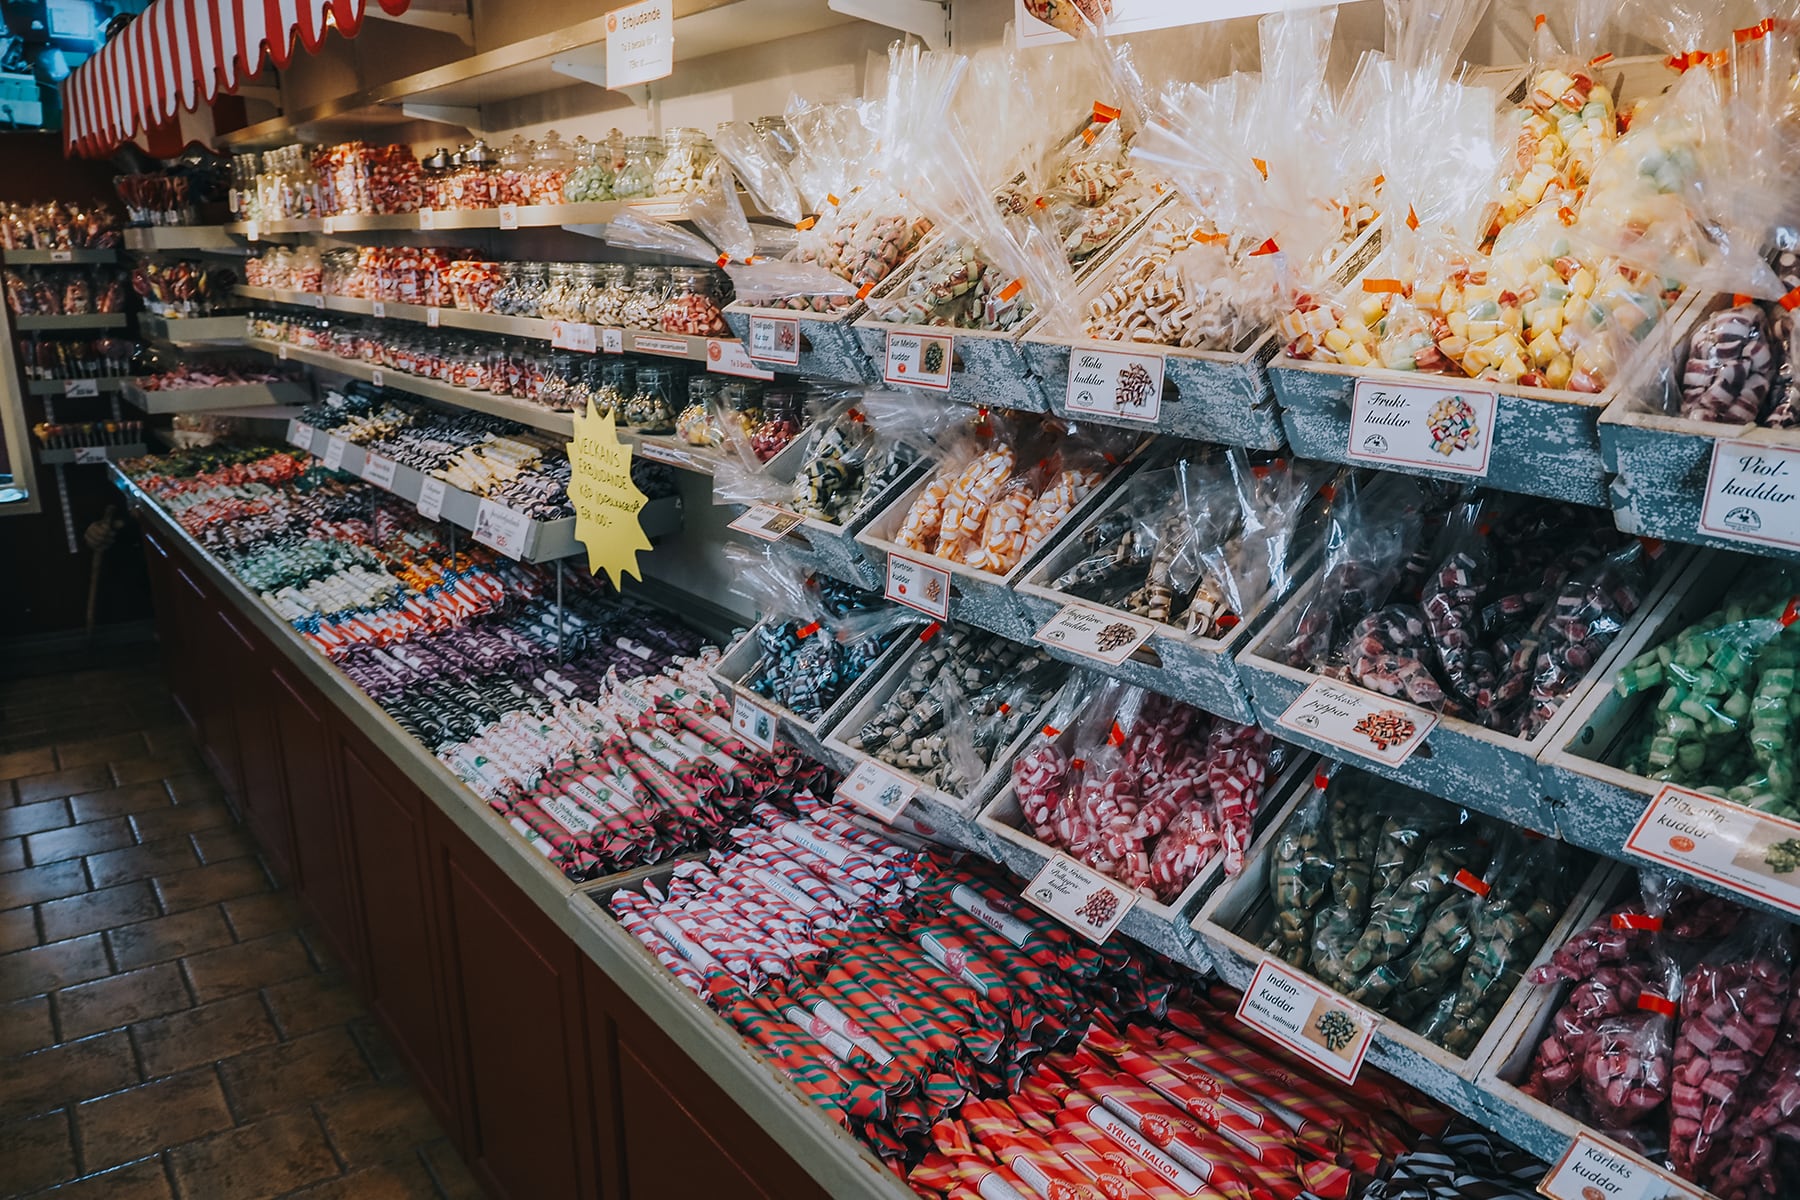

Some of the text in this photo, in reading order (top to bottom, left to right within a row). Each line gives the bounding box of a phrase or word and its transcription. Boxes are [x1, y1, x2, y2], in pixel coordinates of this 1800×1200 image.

[622, 7, 660, 31] Erbjudande
[891, 337, 900, 347] Sur
[1073, 371, 1104, 386] kuddar
[1367, 391, 1411, 408] Frukt-
[1364, 410, 1410, 428] kuddar
[1739, 455, 1789, 477] Viol-
[1721, 477, 1795, 503] kuddar
[1303, 699, 1349, 718] peppar
[1656, 813, 1714, 840] kuddar
[795, 835, 829, 857] FIZZY BUBBLE
[970, 904, 1004, 932] SUR MELON
[1266, 972, 1300, 997] Indian-
[1258, 987, 1295, 1014] Kuddar
[1248, 999, 1299, 1033] (lakrits, salmiak)
[1105, 1122, 1142, 1153] SYRLIGA
[1141, 1148, 1179, 1180] HALLON
[1584, 1146, 1633, 1180] Kärleks
[1571, 1160, 1624, 1196] kuddar
